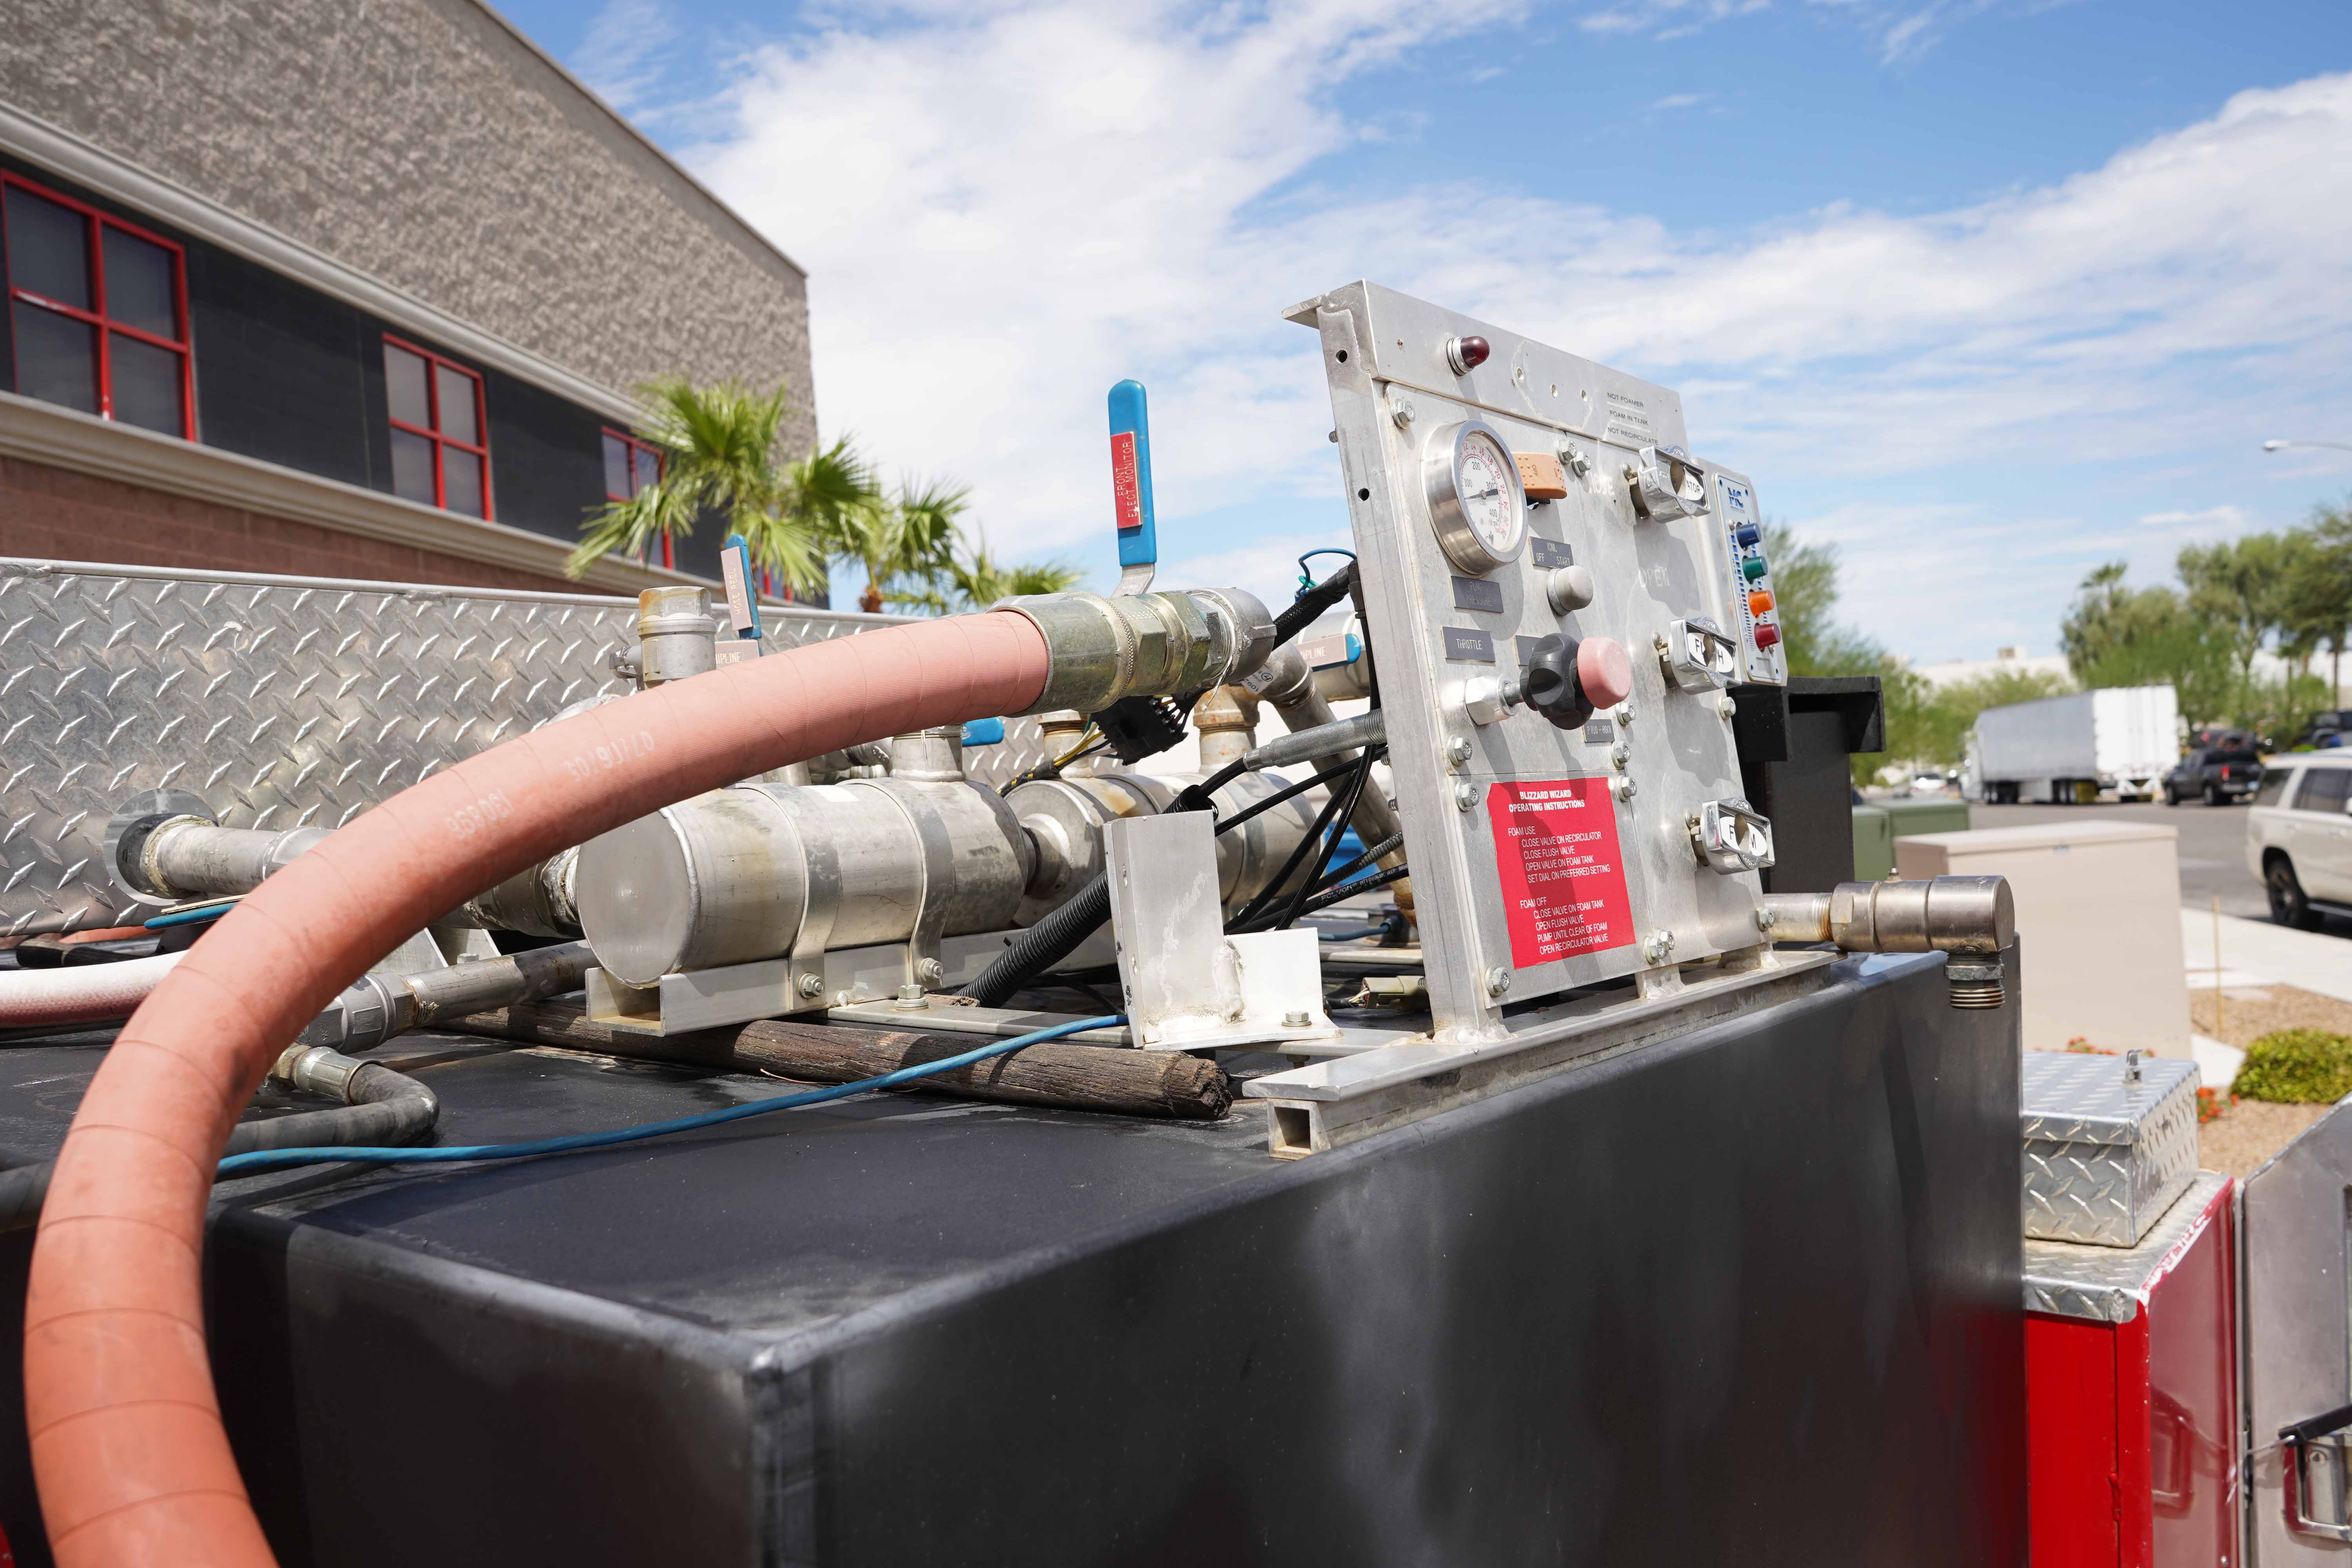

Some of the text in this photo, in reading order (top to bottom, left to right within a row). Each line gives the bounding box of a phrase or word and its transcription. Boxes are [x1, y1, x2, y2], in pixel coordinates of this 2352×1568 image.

[1621, 397, 1644, 407] FOAMER
[1610, 410, 1626, 419] FOAM
[1621, 431, 1658, 445] RECIRCULATE
[1479, 446, 1485, 456] 16
[1472, 461, 1481, 470] 200
[1488, 455, 1493, 465] 18
[1123, 441, 1137, 517] ELECT. MONITOR
[1495, 468, 1500, 479] 20
[1554, 468, 1558, 477] ON
[1116, 468, 1125, 496] FRONT
[1464, 479, 1472, 487] 100
[1536, 553, 1570, 566] OFF START
[728, 568, 737, 590] REEL
[1638, 567, 1670, 587] OPEN
[1470, 582, 1483, 592] PUMP
[1466, 594, 1492, 606] PRESSURE
[1456, 639, 1483, 650] THROTTLE
[715, 652, 742, 664] IPLINE
[1301, 646, 1326, 659] IPLINE
[1695, 639, 1724, 664] FLH
[1520, 789, 1572, 800] BLIZZARD WIZARD
[1509, 799, 1585, 812] OPERATING INSTRUCTIONS
[1508, 826, 1535, 836] FOAM USE
[1521, 831, 1601, 847] CLOSE VALVE ON RECIRCULATOR
[1523, 846, 1575, 859] CLOSE FLUSH VALVE
[1526, 855, 1594, 871] OPEN VALVE ON FOAM TANK
[1528, 864, 1610, 883] SET DIAL ON PREFERRED SETTING
[1520, 897, 1546, 909] FOAM OFF
[1534, 899, 1604, 919] CLOSE VALVE ON FOAM TANK
[1535, 914, 1584, 931] OPEN FLUSH VALVE
[1537, 922, 1608, 943] PUMP UNTIL CLEAR OF FOAM
[1539, 934, 1608, 955] OPEN RECIRCULATOR VALVE
